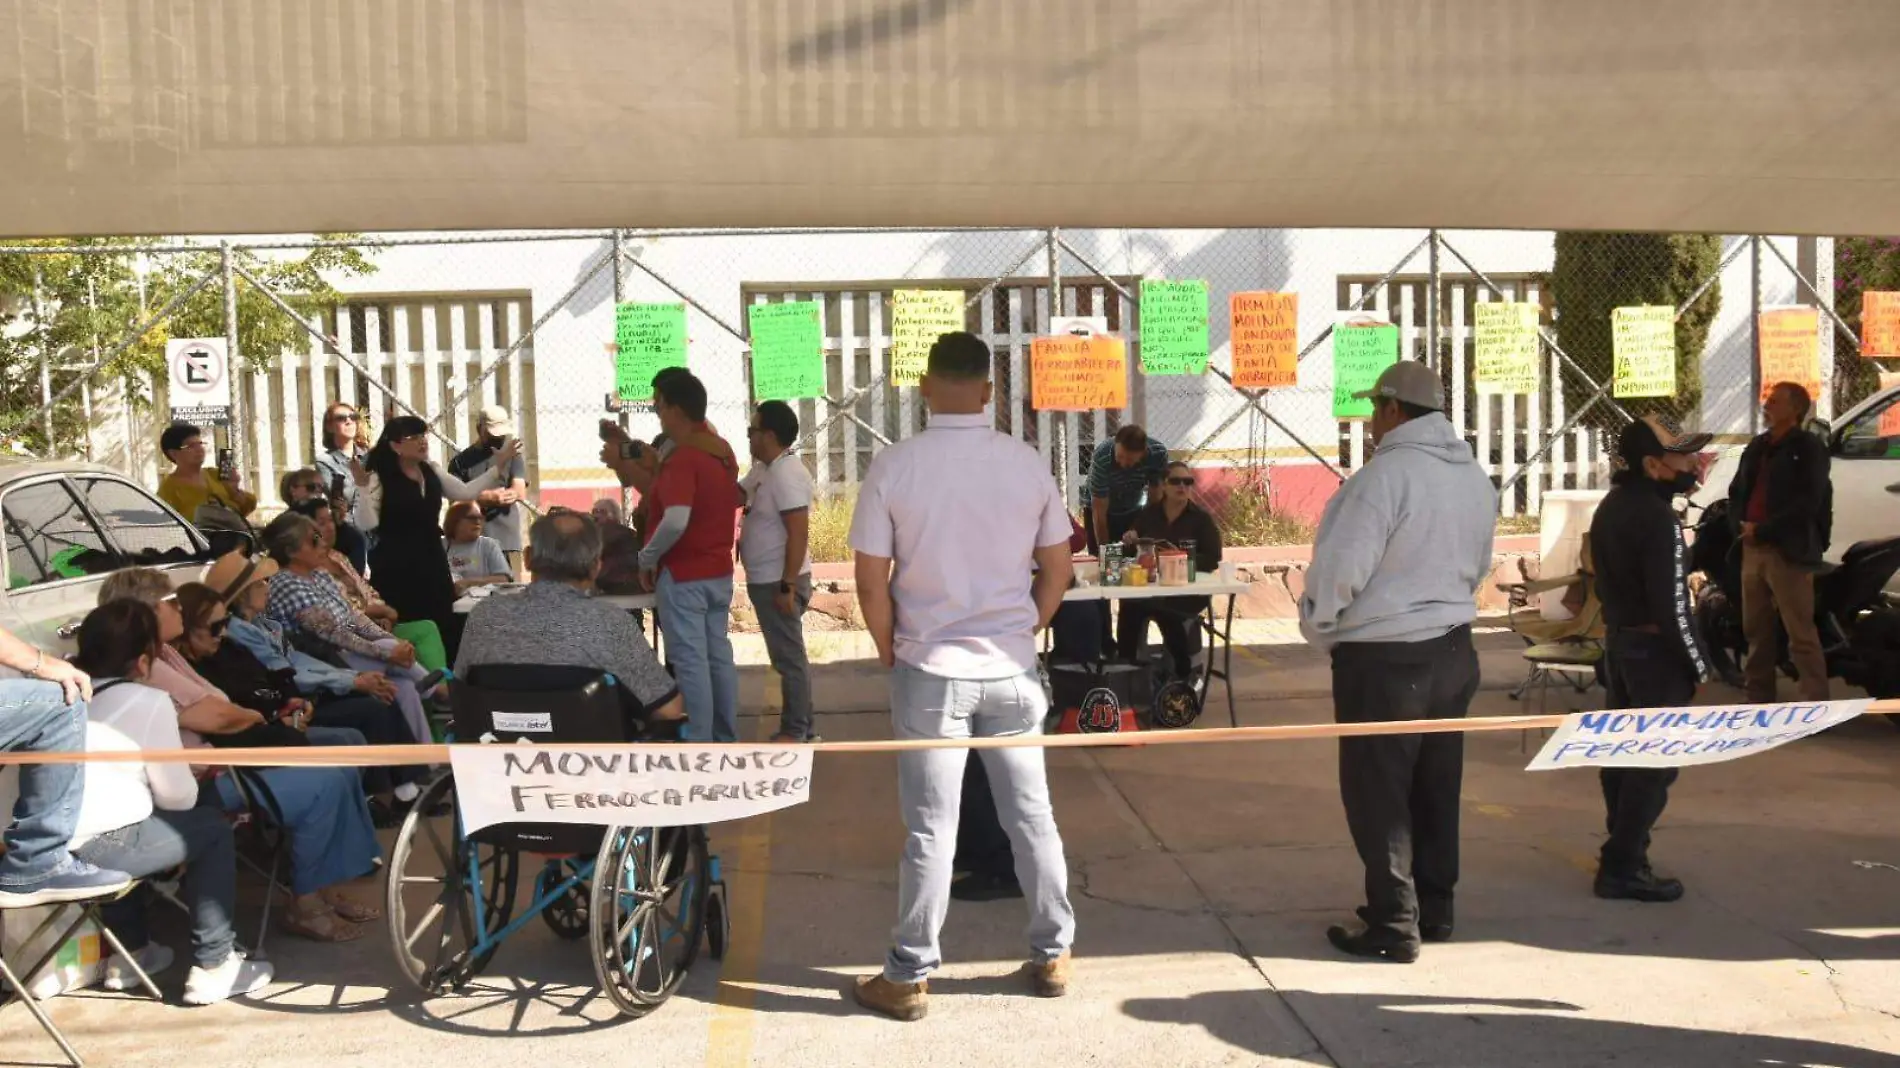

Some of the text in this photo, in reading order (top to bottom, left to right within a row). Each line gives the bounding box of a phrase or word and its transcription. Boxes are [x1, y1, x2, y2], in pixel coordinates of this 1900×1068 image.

[1234, 296, 1293, 312] ARMIDA
[1235, 311, 1284, 327] MOLINA
[1036, 341, 1090, 355] FAMILIA
[1040, 391, 1115, 406] JUSTICIA
[1577, 703, 1829, 735] MOVIMIENTO
[504, 750, 798, 777] MOVIMIENTO
[510, 775, 807, 812] FERROCARRILERO
